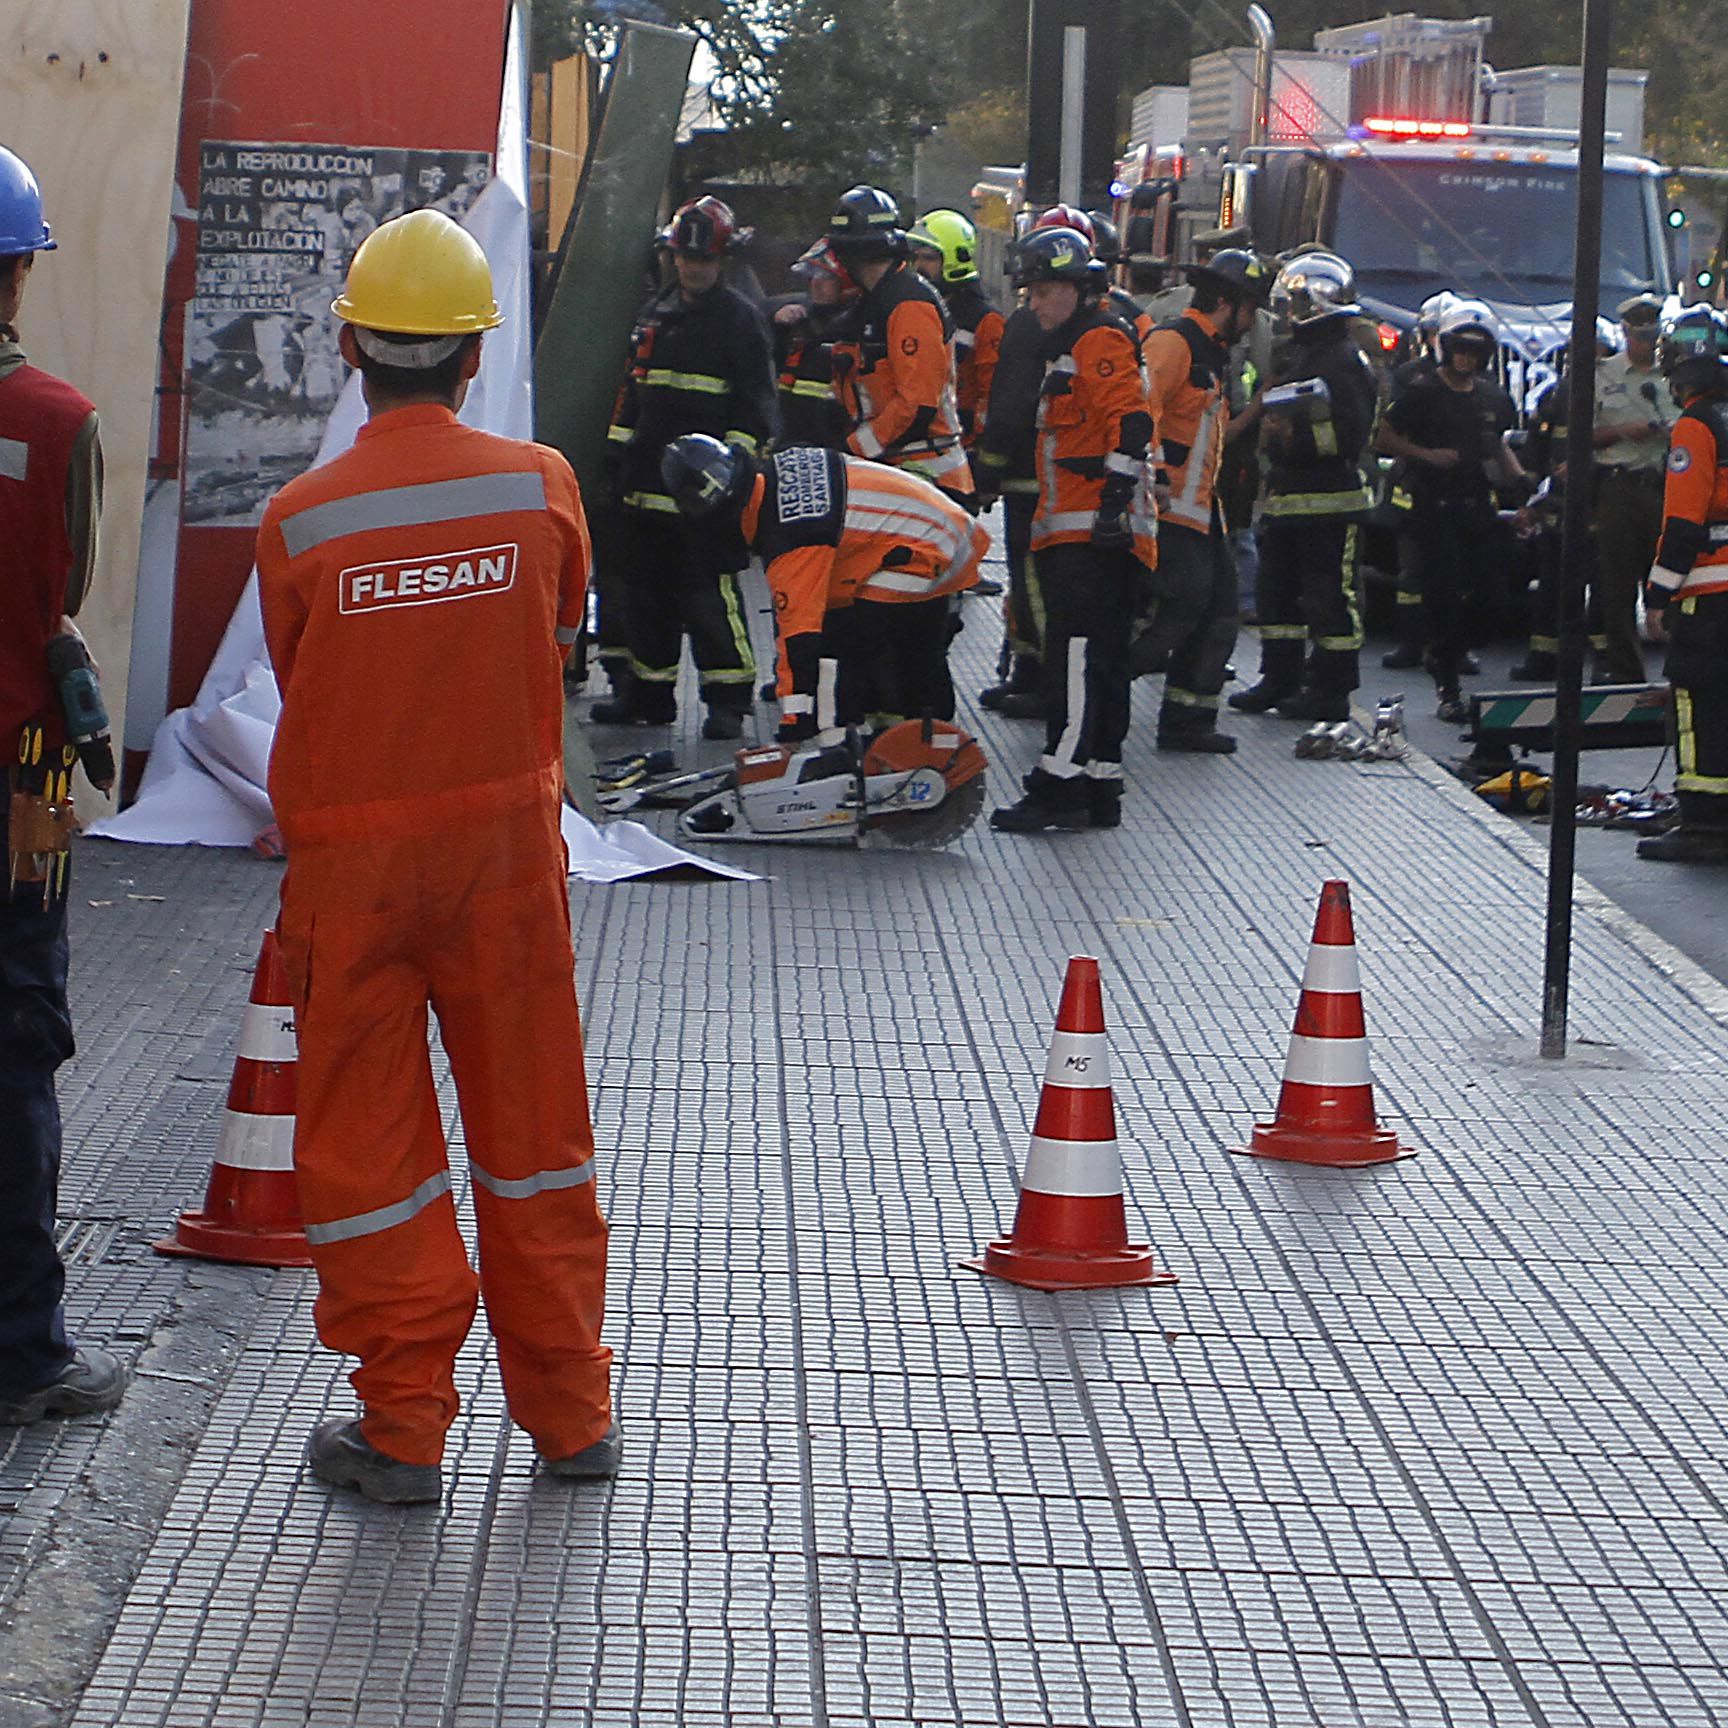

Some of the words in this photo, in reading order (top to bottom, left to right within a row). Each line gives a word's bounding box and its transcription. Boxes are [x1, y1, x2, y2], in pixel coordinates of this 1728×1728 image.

[203, 152, 227, 169] LA
[261, 178, 328, 199] CAMINO
[203, 204, 214, 221] A
[224, 203, 249, 222] LA
[351, 554, 506, 603] FLESAN
[776, 800, 817, 814] STIHL
[1064, 1056, 1092, 1073] M5
